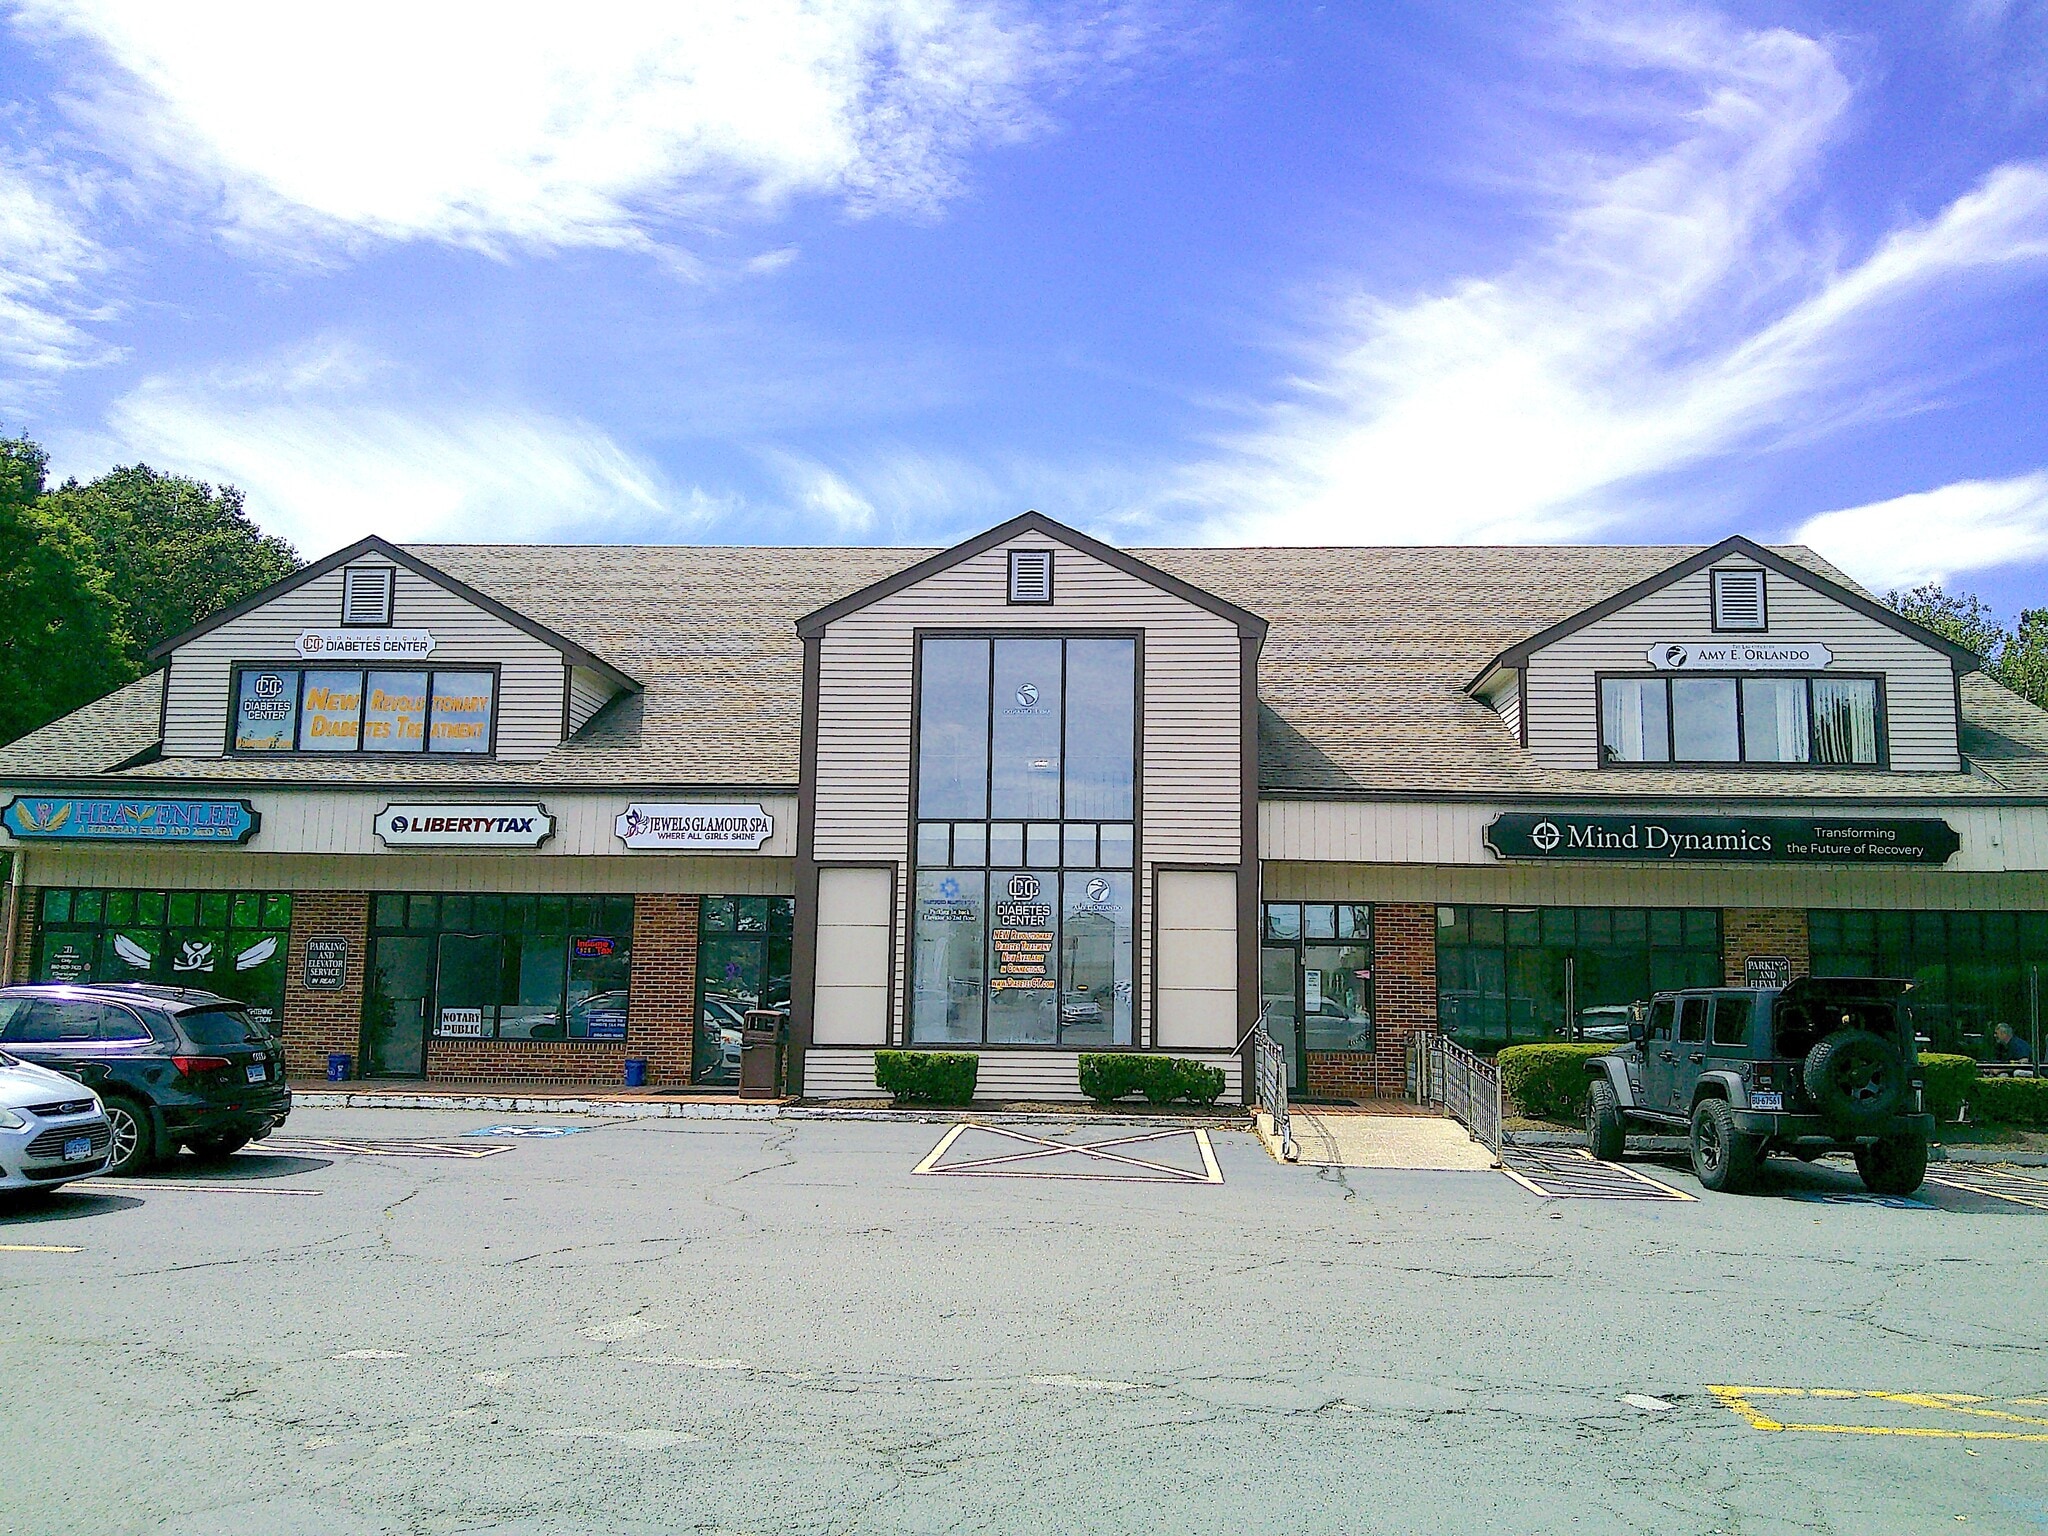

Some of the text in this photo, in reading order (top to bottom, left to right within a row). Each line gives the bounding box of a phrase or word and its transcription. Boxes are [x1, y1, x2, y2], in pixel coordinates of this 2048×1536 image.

[326, 641, 428, 652] DIABETES CENTER
[1698, 649, 1810, 661] AMY E. ORLANDO
[306, 687, 489, 712] NEW REVOLUTIONARY
[244, 701, 291, 711] DIABETES
[247, 710, 286, 720] CENTER
[310, 715, 485, 739] DIABETES TREATMENT
[650, 817, 769, 833] JEWELS GLAMOUR SPA
[170, 827, 191, 836] AND
[217, 828, 233, 837] SPA
[1814, 827, 1896, 841] Transforming
[1566, 825, 1772, 858] Mind Dynamics
[1786, 843, 1924, 857] the Future of Recovery
[997, 905, 1050, 915] DIABETES
[1002, 915, 1045, 925] CENTER
[993, 929, 1010, 940] NEW
[309, 942, 345, 951] PARKING
[577, 939, 609, 947] Income
[317, 951, 335, 959] AND
[1748, 961, 1787, 970] PARKING
[310, 968, 340, 976] SERVICE
[1759, 971, 1776, 979] AND
[1750, 980, 1788, 988] ELEVATR
[443, 1012, 480, 1022] NOTARY
[443, 1024, 480, 1034] PUBLIC
